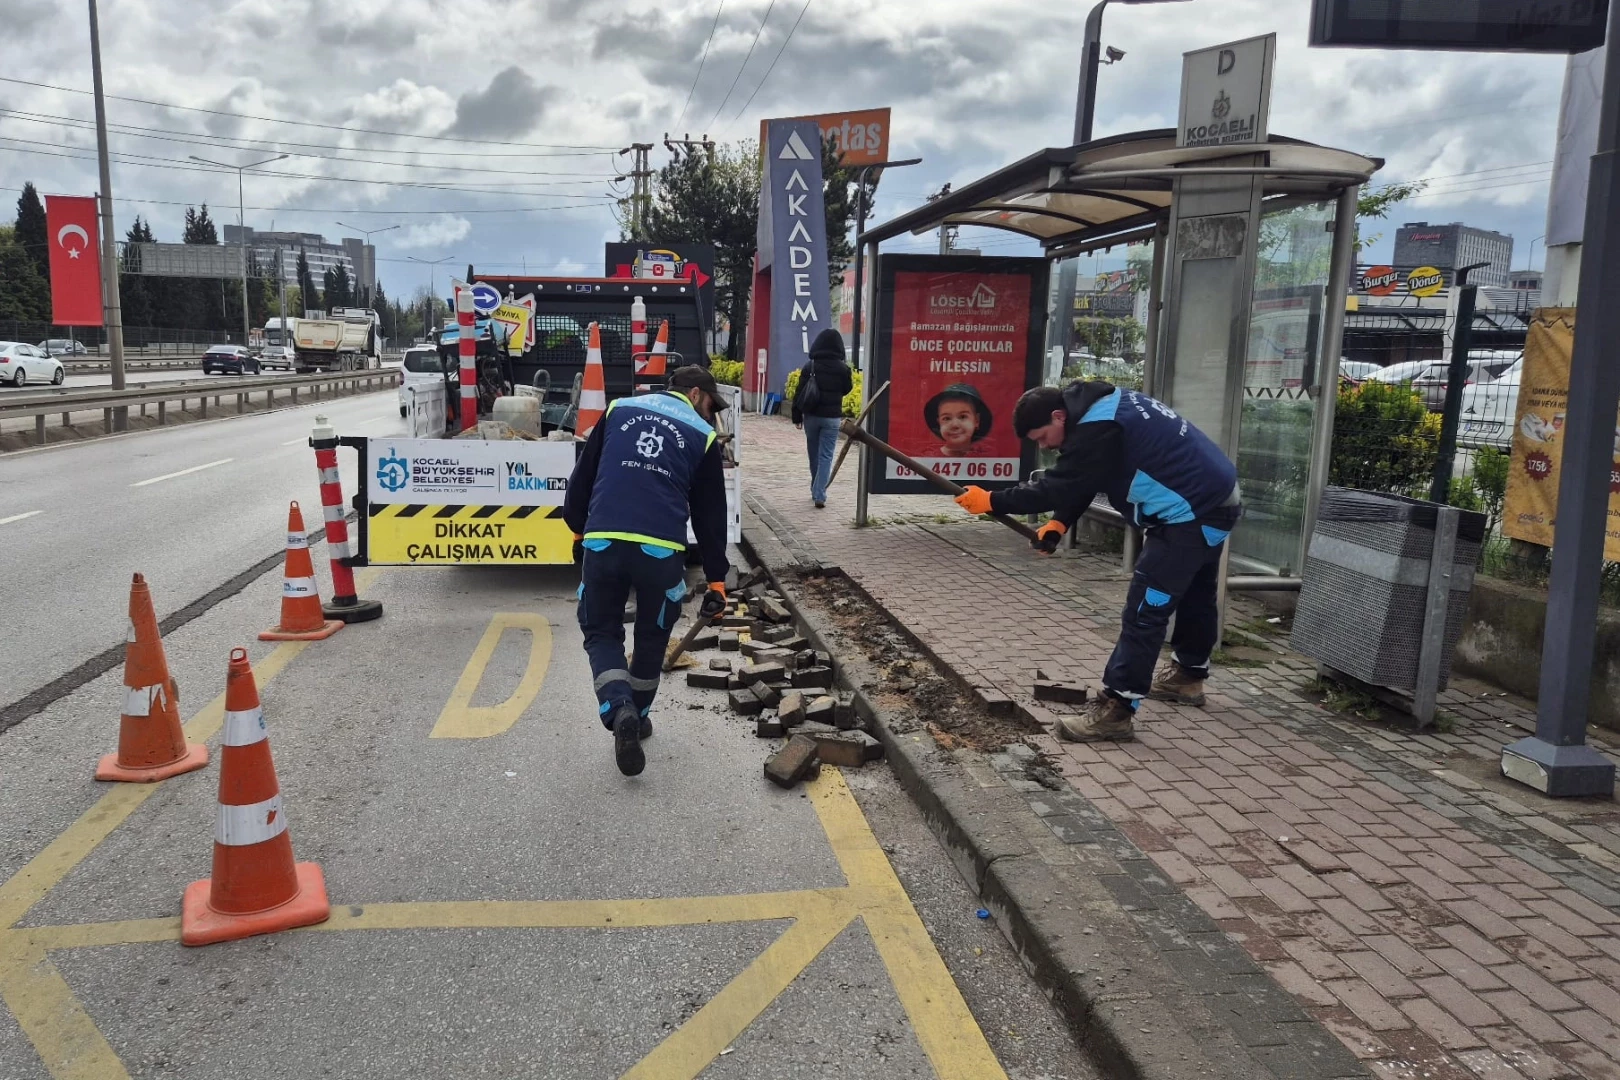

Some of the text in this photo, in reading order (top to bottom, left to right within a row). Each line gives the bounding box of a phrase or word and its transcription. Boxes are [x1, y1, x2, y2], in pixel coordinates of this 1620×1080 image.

[1217, 49, 1236, 76] D
[1362, 271, 1400, 289] Burger
[1409, 274, 1442, 289] Döner
[931, 294, 976, 308] LÖSEV
[910, 321, 951, 331] Ramazan
[910, 337, 1013, 355] ÖNCE ÇOCUKLAR
[930, 358, 991, 375] İYİLEŞSİN
[412, 466, 495, 477] BÜYÜKŞEHİR
[505, 461, 533, 477] YOL
[621, 460, 641, 468] FEN
[931, 462, 962, 477] 447
[967, 462, 987, 477] 06
[993, 462, 1013, 477] 60
[412, 476, 475, 484] BELEDİYESİ
[434, 519, 506, 539] DİKKAT
[406, 543, 538, 562] ÇALIŞMA VAR
[428, 612, 554, 739] D
